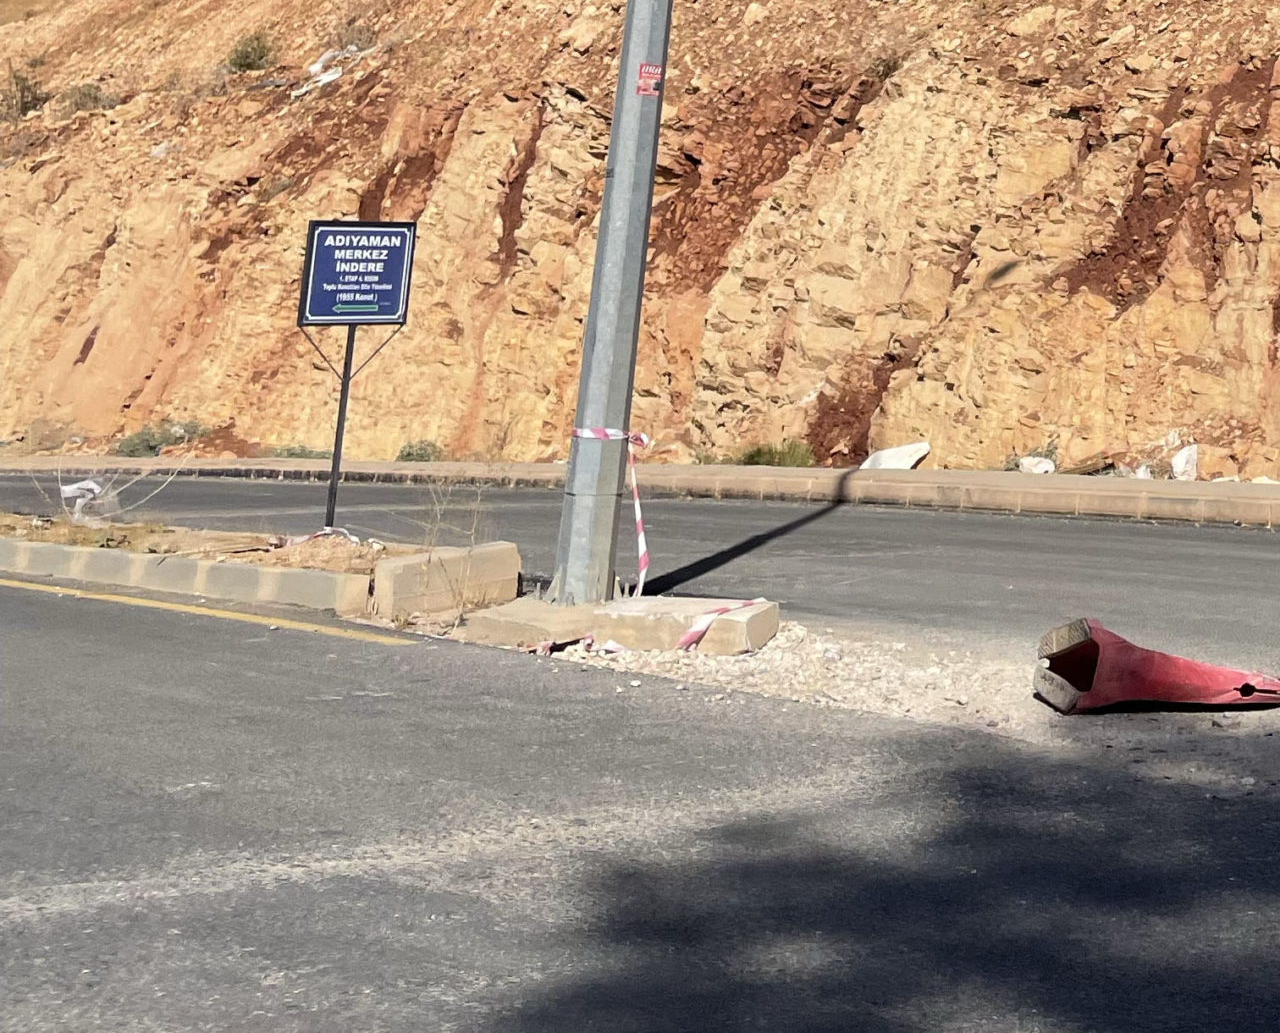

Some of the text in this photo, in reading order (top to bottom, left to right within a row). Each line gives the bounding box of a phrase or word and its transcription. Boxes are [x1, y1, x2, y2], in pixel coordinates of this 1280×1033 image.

[324, 234, 402, 247] ADIYAMAN
[334, 249, 389, 260] MERKEZ
[335, 260, 385, 273] İNDERE
